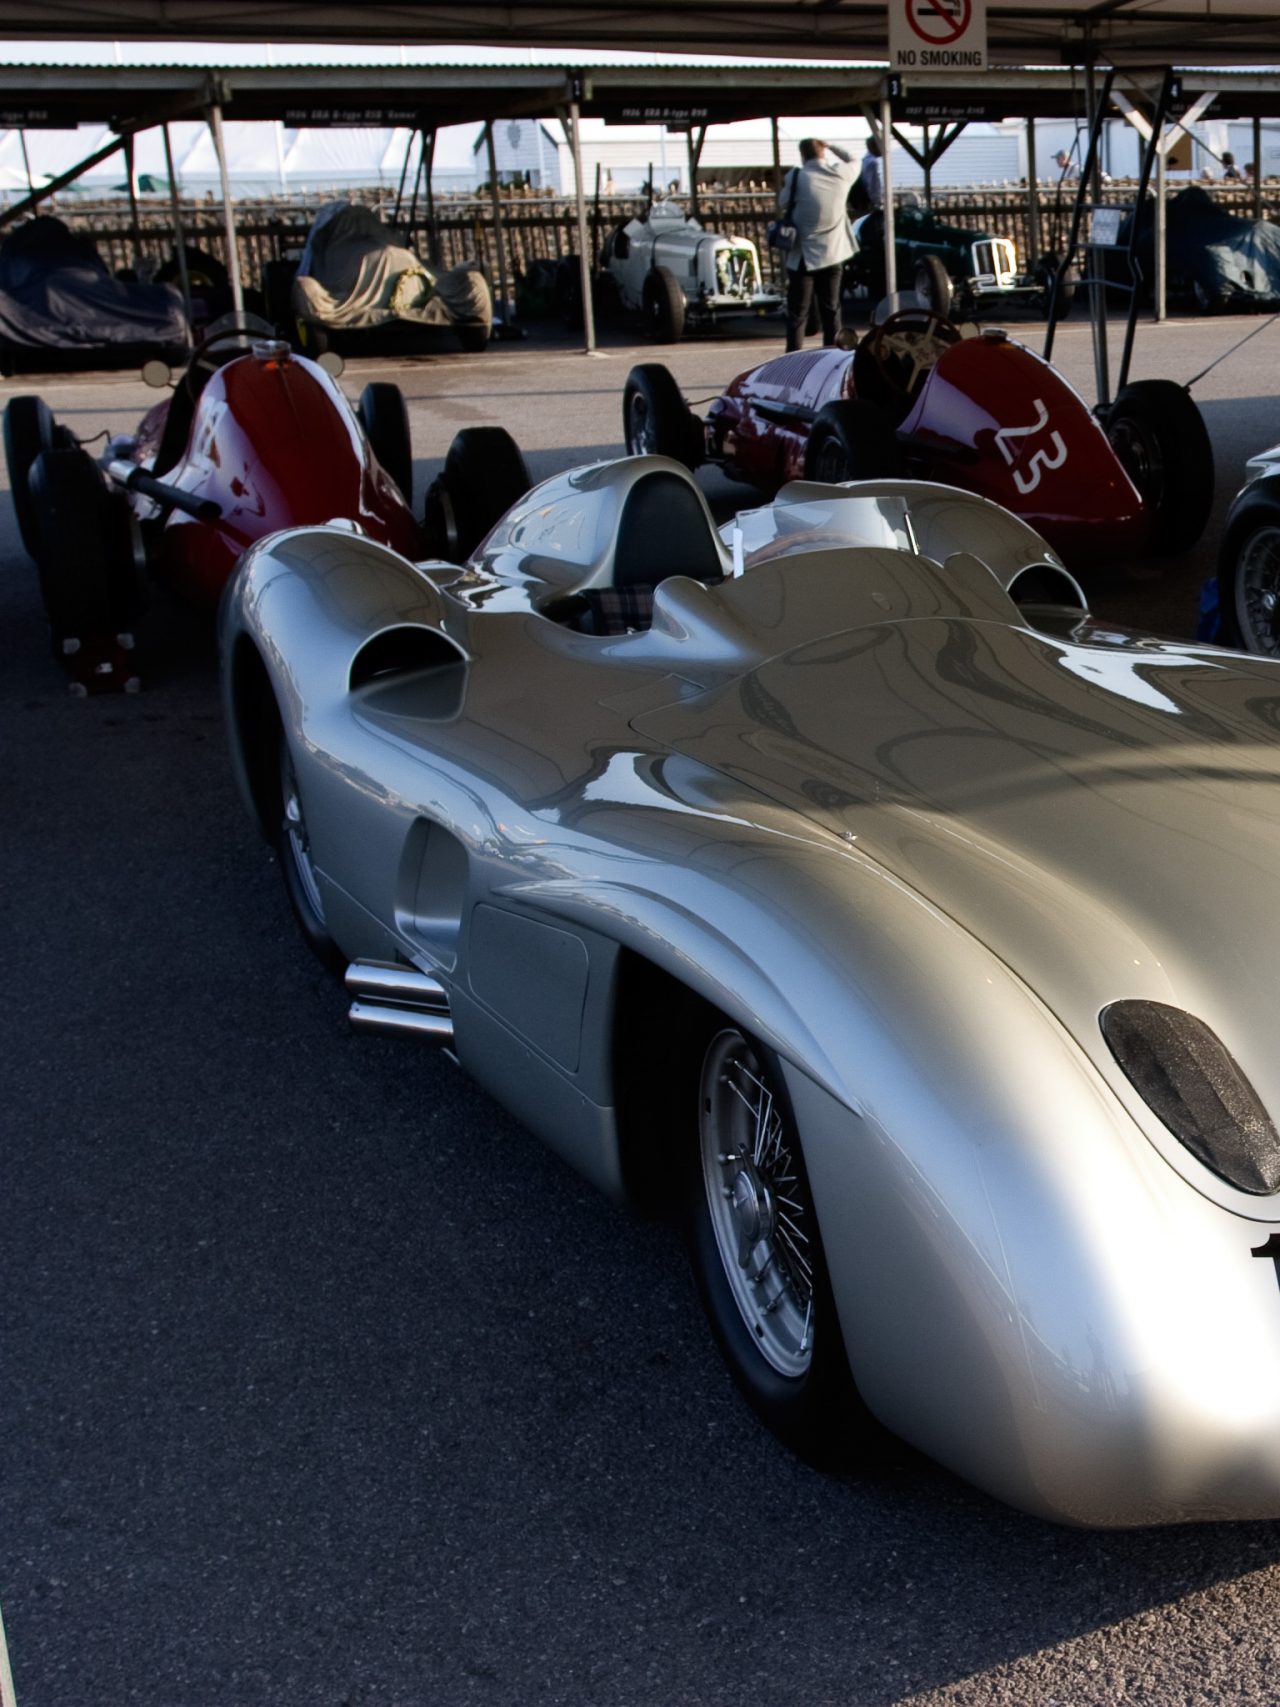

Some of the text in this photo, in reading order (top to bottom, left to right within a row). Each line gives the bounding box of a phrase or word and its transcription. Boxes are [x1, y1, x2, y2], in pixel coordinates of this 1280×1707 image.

[898, 50, 982, 66] NO SMOKING
[994, 398, 1067, 494] 23
